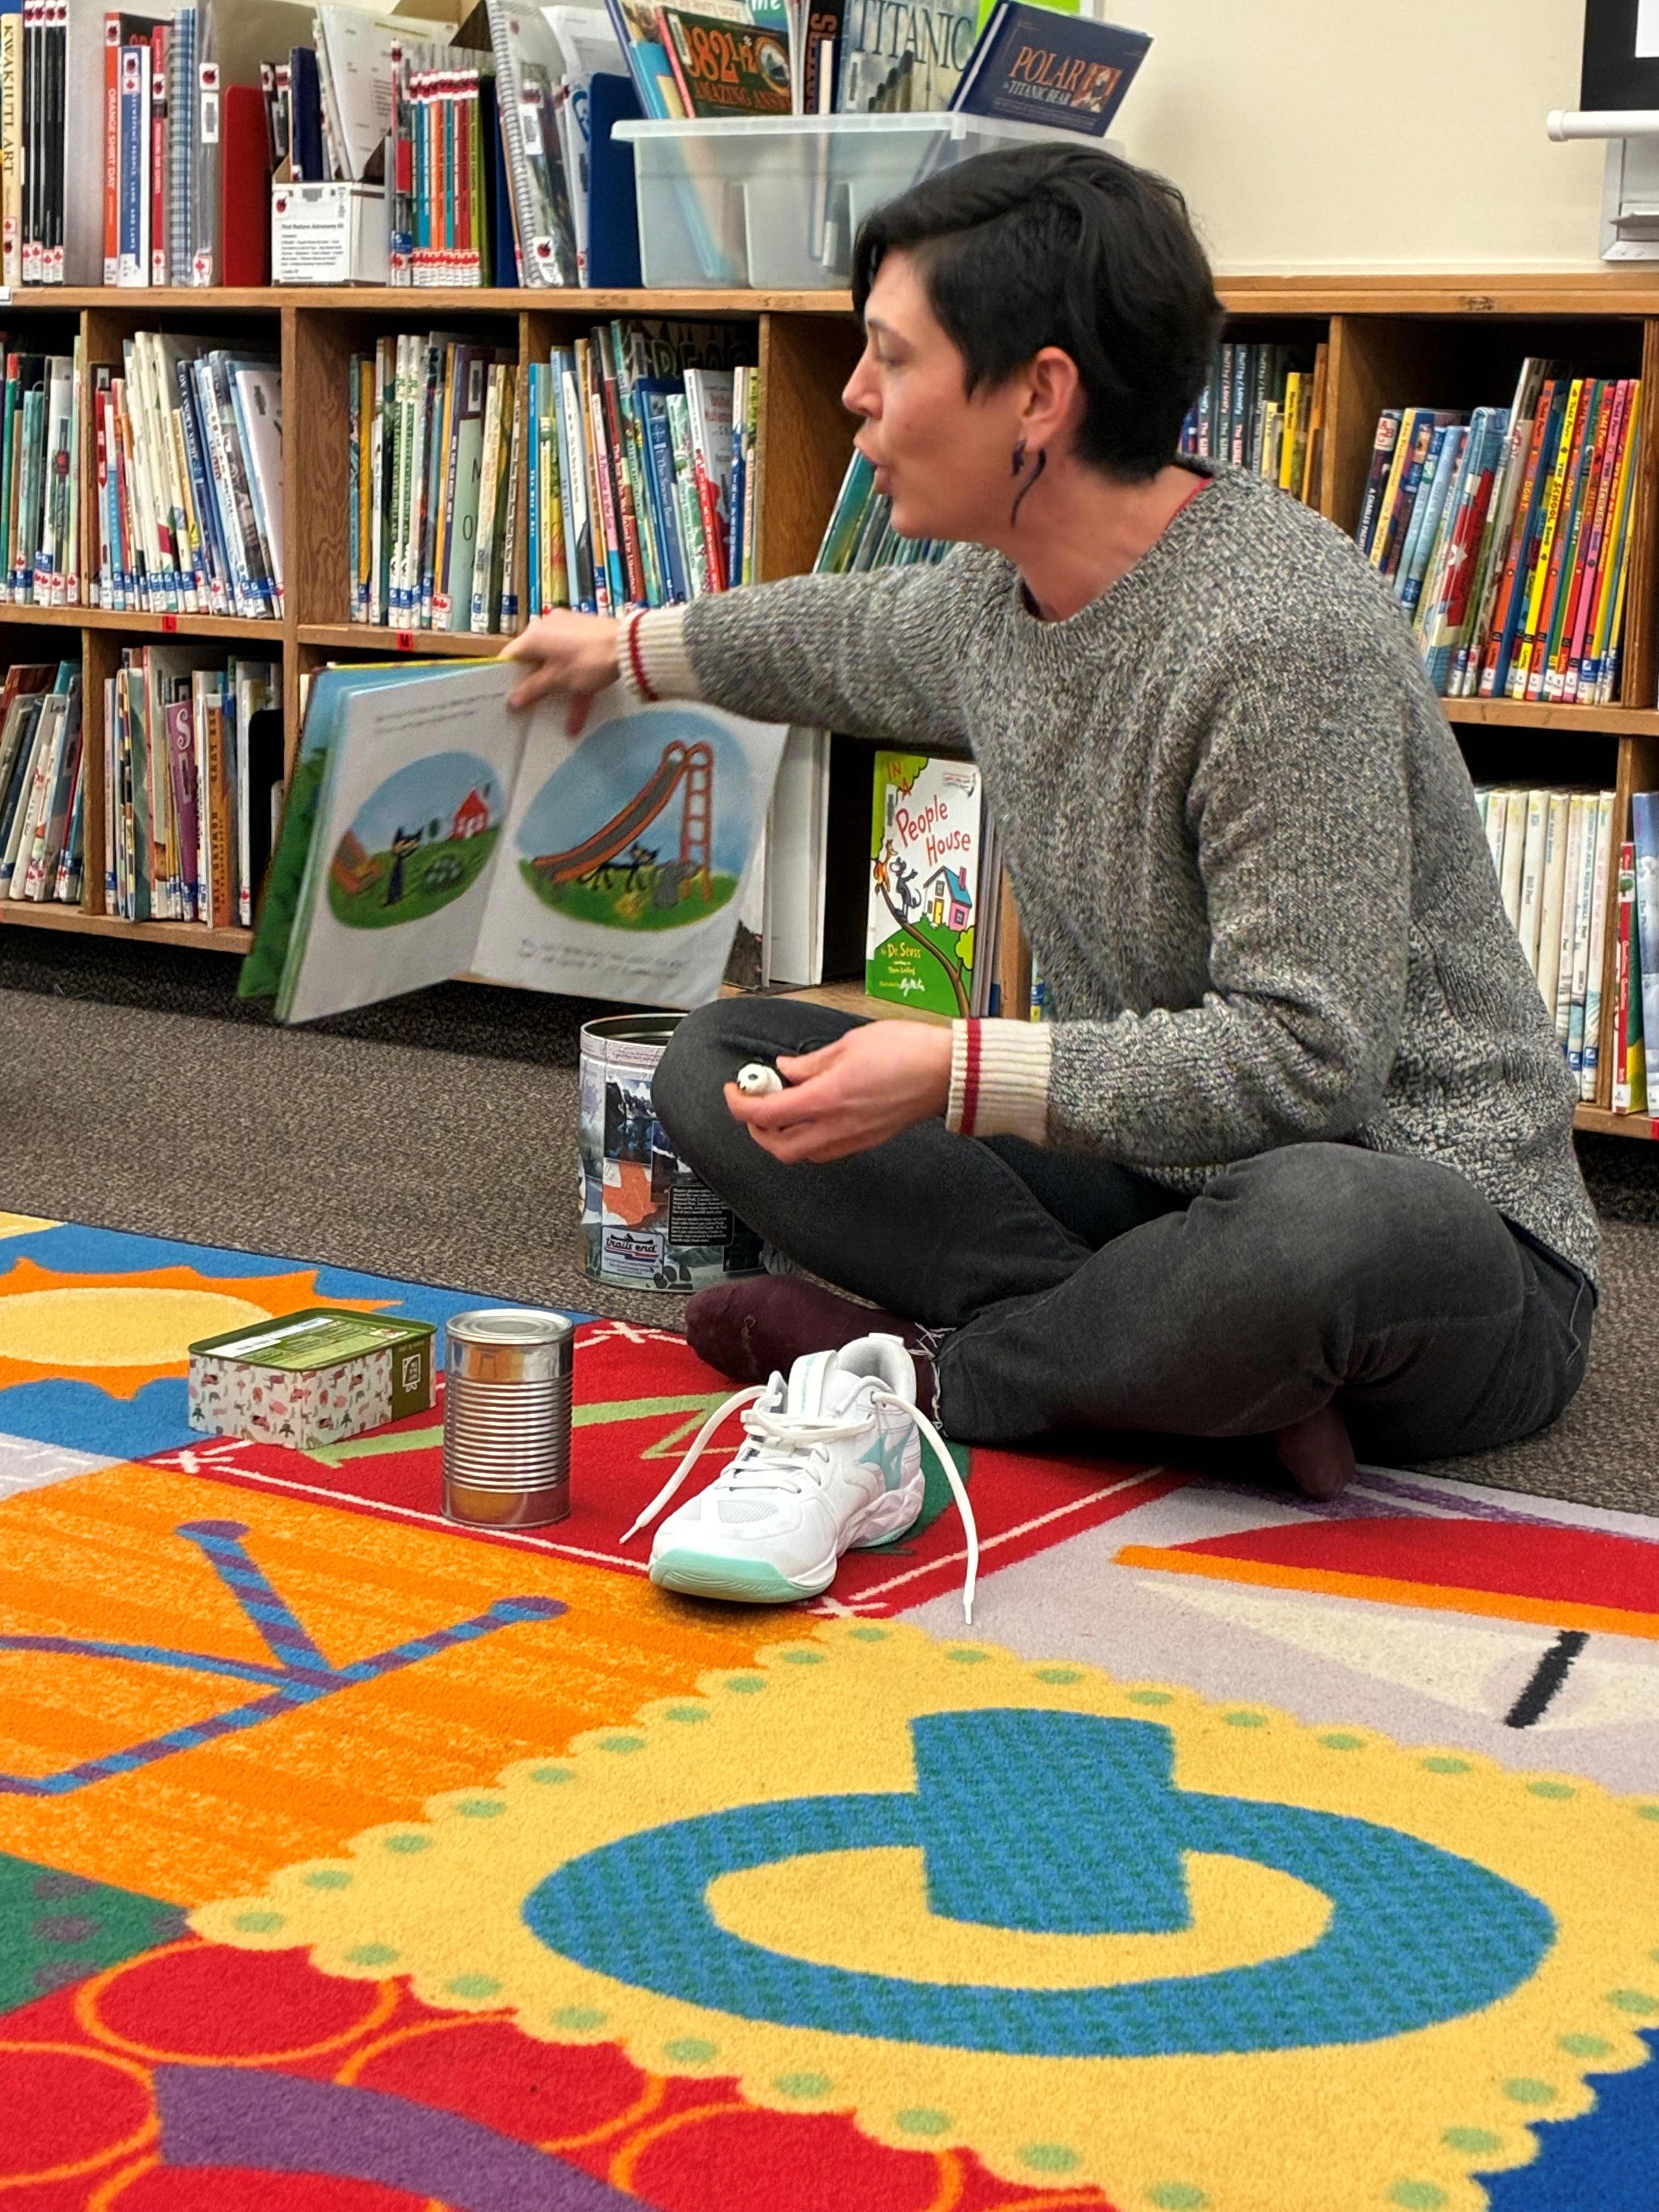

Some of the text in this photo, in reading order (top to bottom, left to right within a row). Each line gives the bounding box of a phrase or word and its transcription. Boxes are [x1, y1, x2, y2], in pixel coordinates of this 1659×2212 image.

[1008, 46, 1087, 92] POLAR
[3, 26, 15, 176] KWAKIUTL ART
[693, 81, 752, 108] AMAZING
[1008, 80, 1071, 106] TITANIC BEAR
[108, 88, 116, 133] ORANGE
[108, 136, 116, 165] SHIRT
[1539, 401, 1548, 418] Todd
[1568, 402, 1577, 419] Todd
[1600, 408, 1610, 428] Todd
[1612, 400, 1622, 418] Todd
[1536, 420, 1544, 438] Parr
[1565, 421, 1573, 438] Parr
[1576, 419, 1584, 436] Parr
[1597, 430, 1606, 449] Parr
[600, 462, 609, 491] Promise
[603, 492, 609, 501] to
[656, 456, 673, 528] The Snow Bear
[1547, 481, 1562, 523] SCHOOL
[1362, 494, 1376, 524] CHARLES
[1594, 479, 1609, 529] KINDNESS
[506, 518, 515, 535] What
[606, 515, 614, 529] Sun
[506, 537, 514, 547] Do
[624, 542, 632, 553] by
[505, 548, 513, 560] You
[626, 554, 637, 596] Librarians
[165, 617, 172, 629] L
[400, 634, 409, 647] M
[210, 744, 218, 783] LUND
[886, 761, 901, 782] IN
[901, 777, 912, 799] A
[895, 794, 949, 848] People
[211, 811, 219, 871] HOWARD
[926, 830, 971, 867] House
[887, 942, 921, 958] Dr. Seuss
[606, 1237, 658, 1253] trails end
